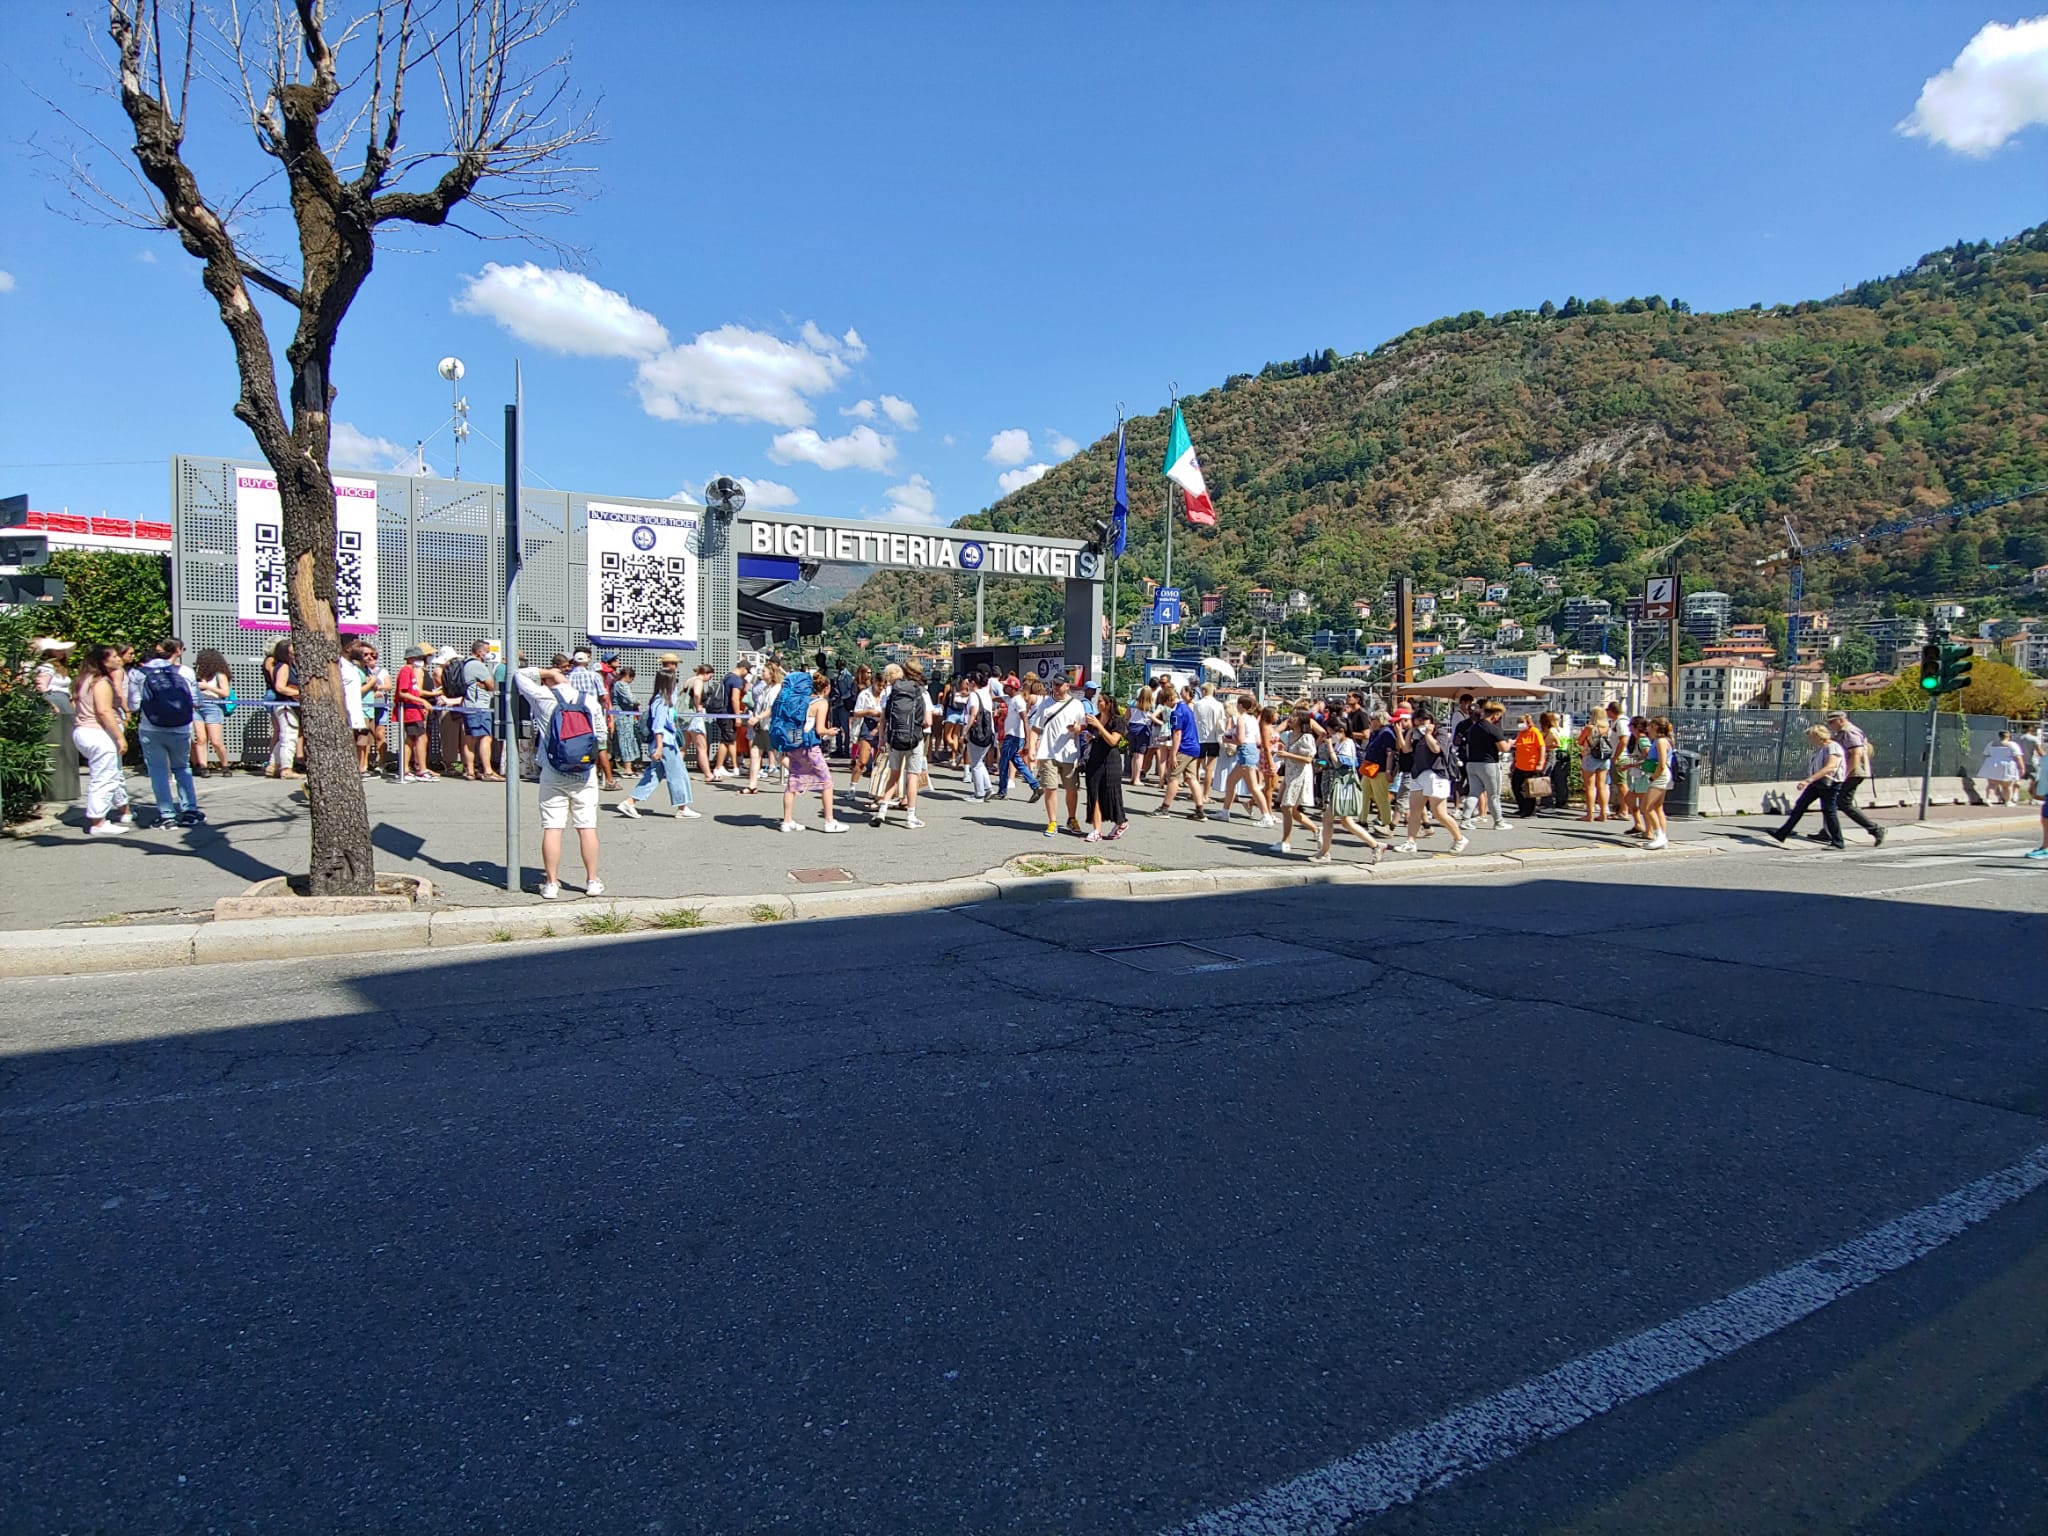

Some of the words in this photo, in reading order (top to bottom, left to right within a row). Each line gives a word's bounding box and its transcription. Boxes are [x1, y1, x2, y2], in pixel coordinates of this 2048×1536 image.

[241, 478, 261, 488] BUY
[341, 487, 373, 498] TICKET
[591, 510, 608, 520] BUY
[610, 513, 642, 524] ONLINE
[644, 515, 668, 526] YOUR
[669, 518, 695, 528] TICKET
[751, 521, 957, 568] BIGLIETTERIA
[988, 542, 1098, 578] TICKETS
[1162, 607, 1171, 619] 4
